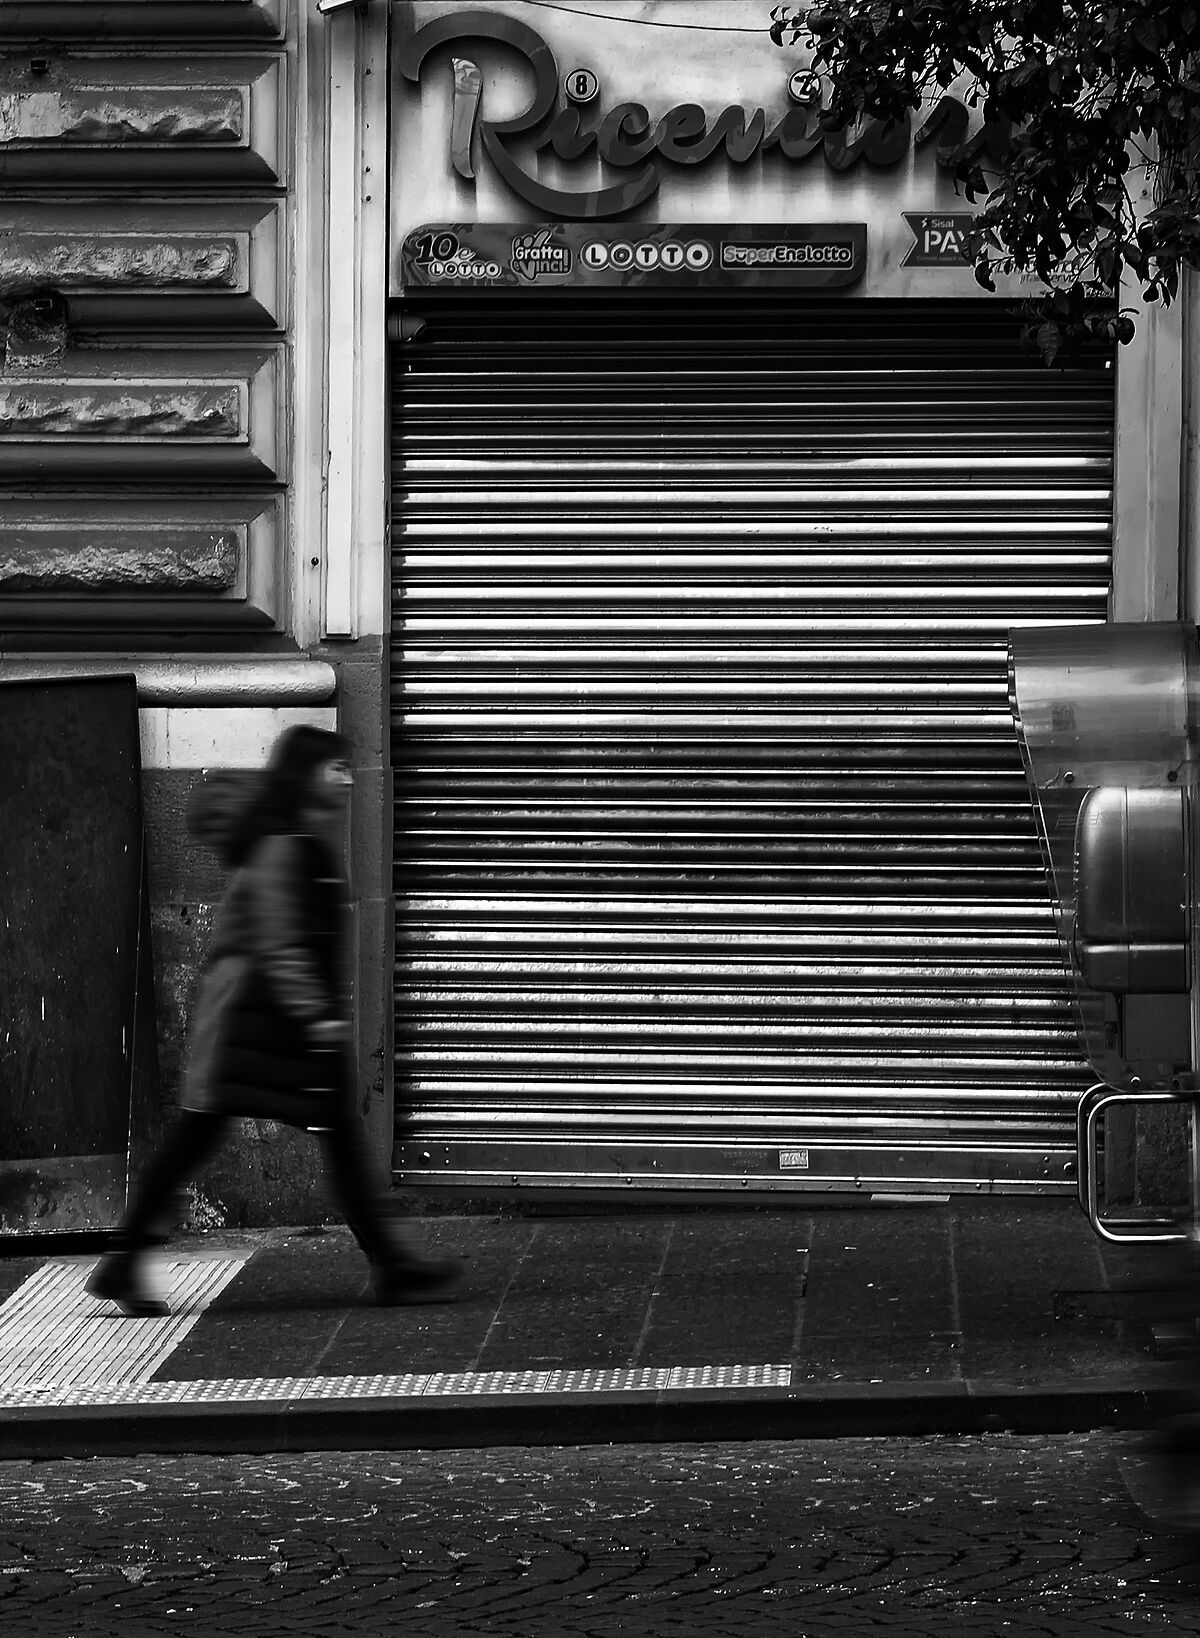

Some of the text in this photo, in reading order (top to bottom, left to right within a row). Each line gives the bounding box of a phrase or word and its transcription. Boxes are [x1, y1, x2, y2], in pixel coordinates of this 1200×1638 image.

[575, 74, 588, 95] 8
[415, 232, 460, 263] 10
[514, 247, 564, 260] Gratta
[585, 241, 711, 270] LOTTO
[723, 245, 852, 264] SuperEnalotto
[428, 260, 502, 278] LOTTO
